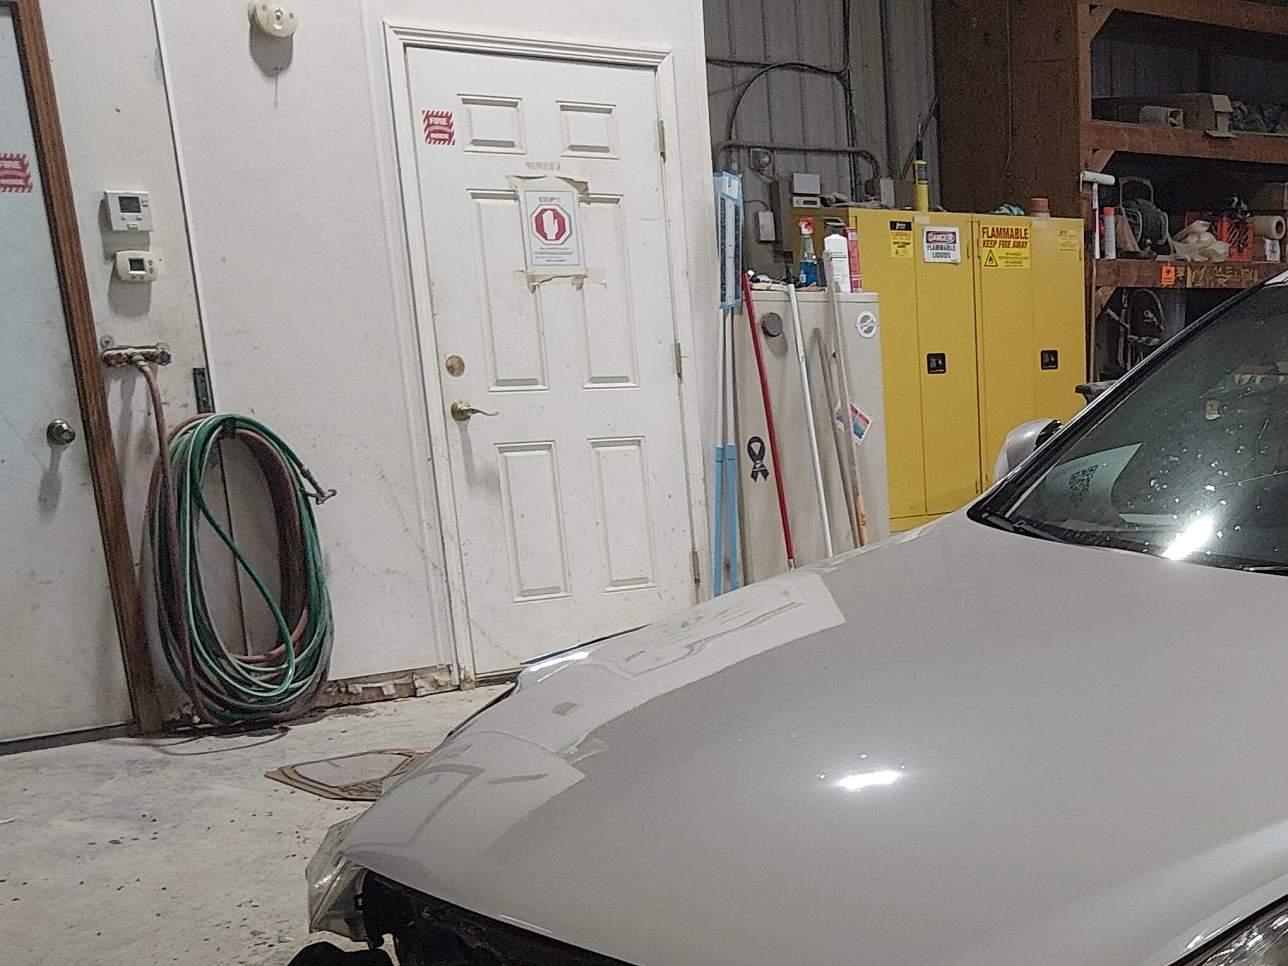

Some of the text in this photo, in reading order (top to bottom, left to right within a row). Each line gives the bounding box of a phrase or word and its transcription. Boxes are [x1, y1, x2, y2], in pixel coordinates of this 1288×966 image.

[927, 233, 955, 242] DANGER
[982, 227, 1029, 240] FLAMMABLE
[982, 240, 998, 248] KEEP
[998, 240, 1011, 248] FIRE
